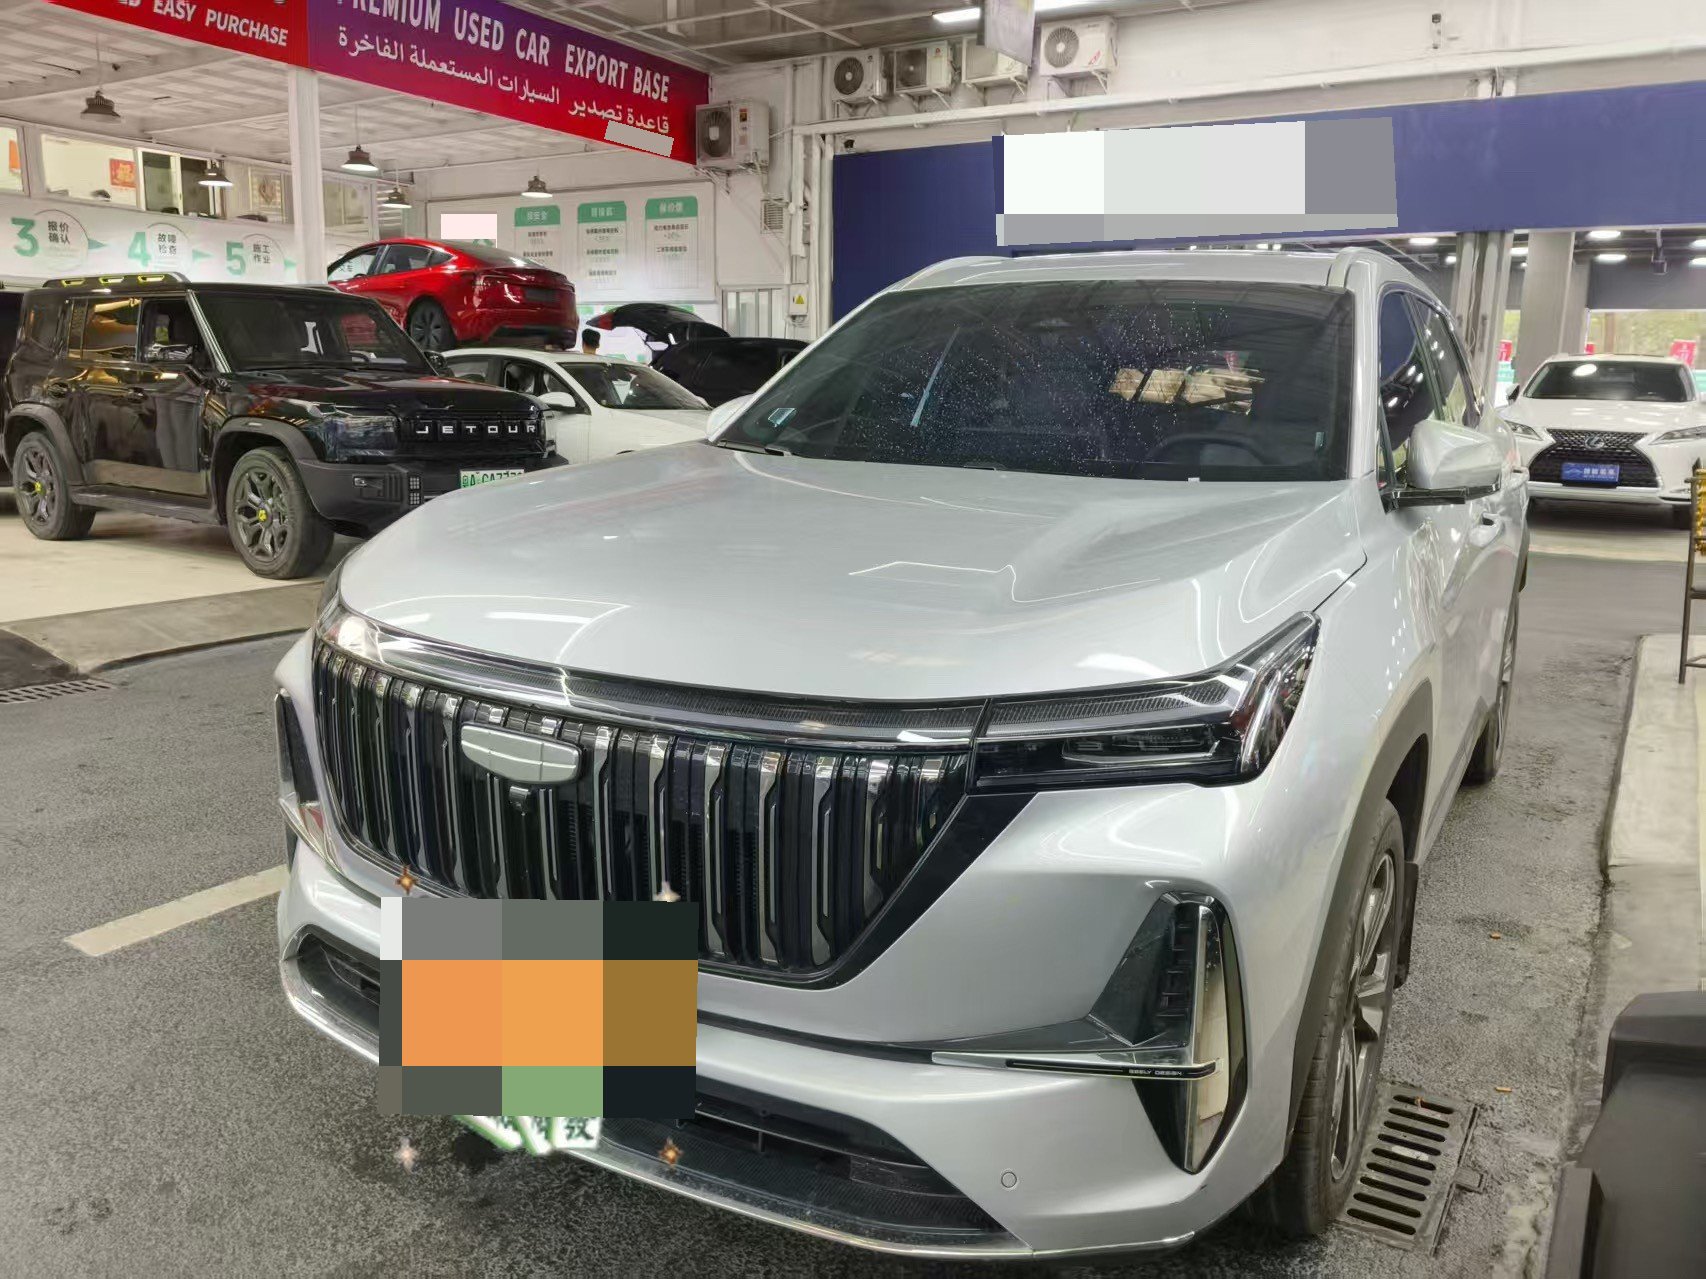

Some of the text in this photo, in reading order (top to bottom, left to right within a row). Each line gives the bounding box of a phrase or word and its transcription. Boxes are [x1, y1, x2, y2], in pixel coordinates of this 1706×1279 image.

[153, 0, 289, 47] EASY PURCHASE
[454, 7, 504, 51] USED
[515, 28, 551, 66] CAR
[565, 43, 629, 90] EXPORT
[632, 66, 670, 103] BASE
[338, 25, 670, 134] قاعدة تصدير السيارات المستعملة الفاخرة
[11, 216, 40, 257] 3
[128, 231, 152, 267] 4
[226, 241, 246, 276] 5
[416, 424, 536, 434] JETOUR
